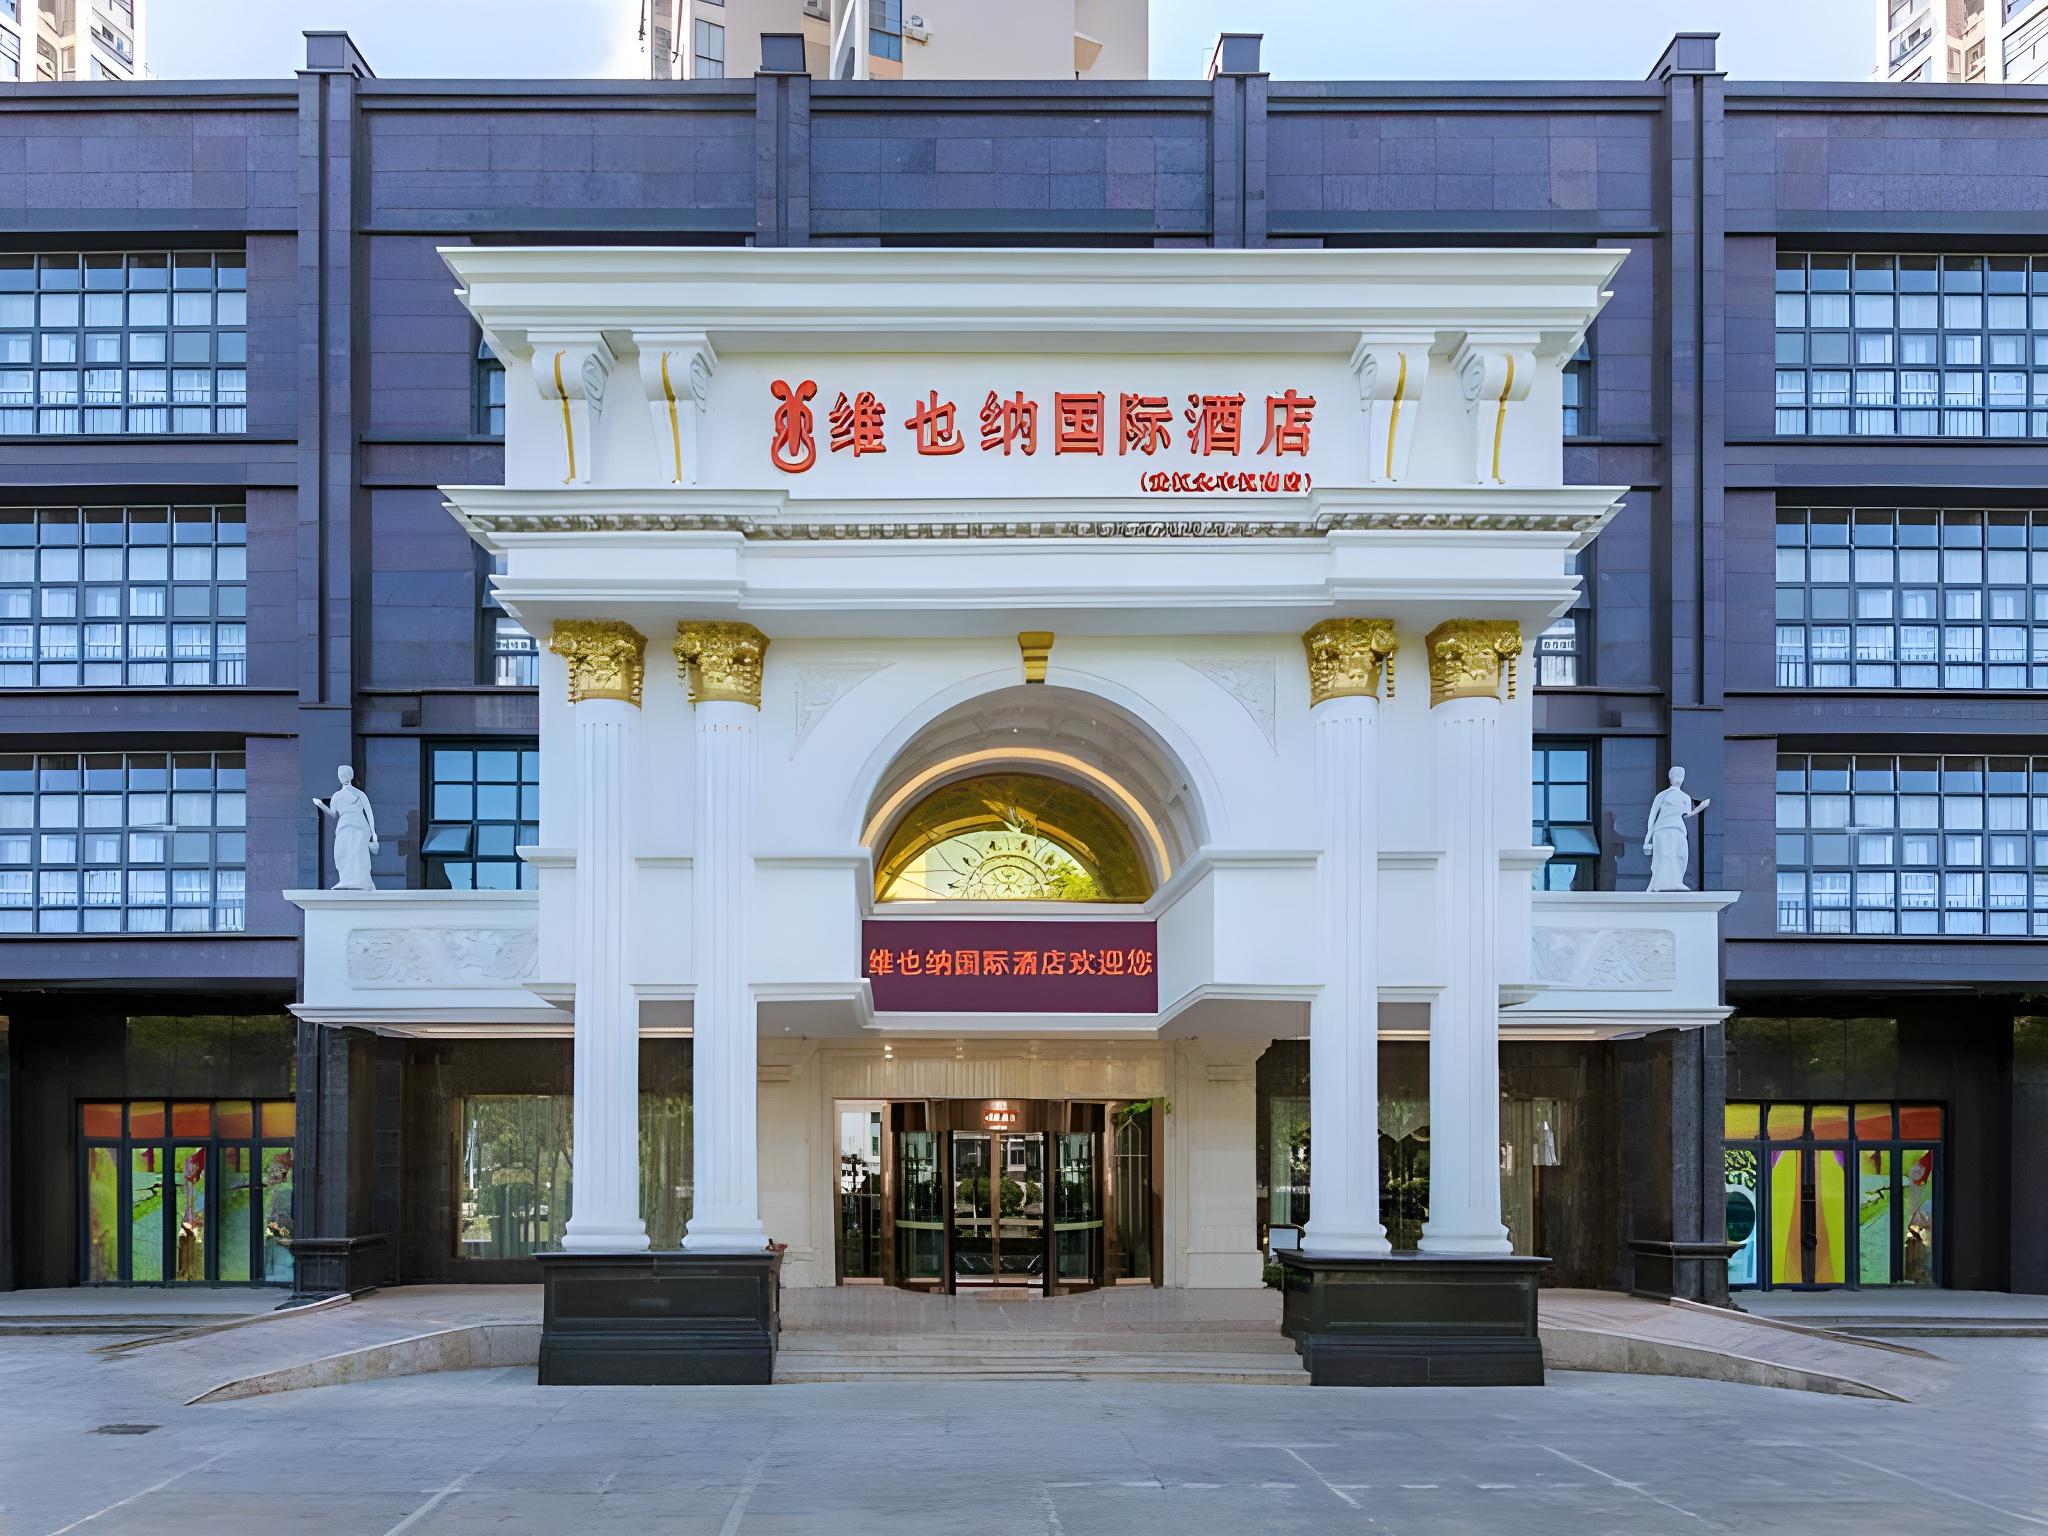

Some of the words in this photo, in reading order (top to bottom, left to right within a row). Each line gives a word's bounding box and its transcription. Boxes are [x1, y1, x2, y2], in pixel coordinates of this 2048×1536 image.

[829, 388, 1317, 458] 维也纳国际酒店
[868, 947, 1153, 977] 维也纳国际酒店欢迎您
